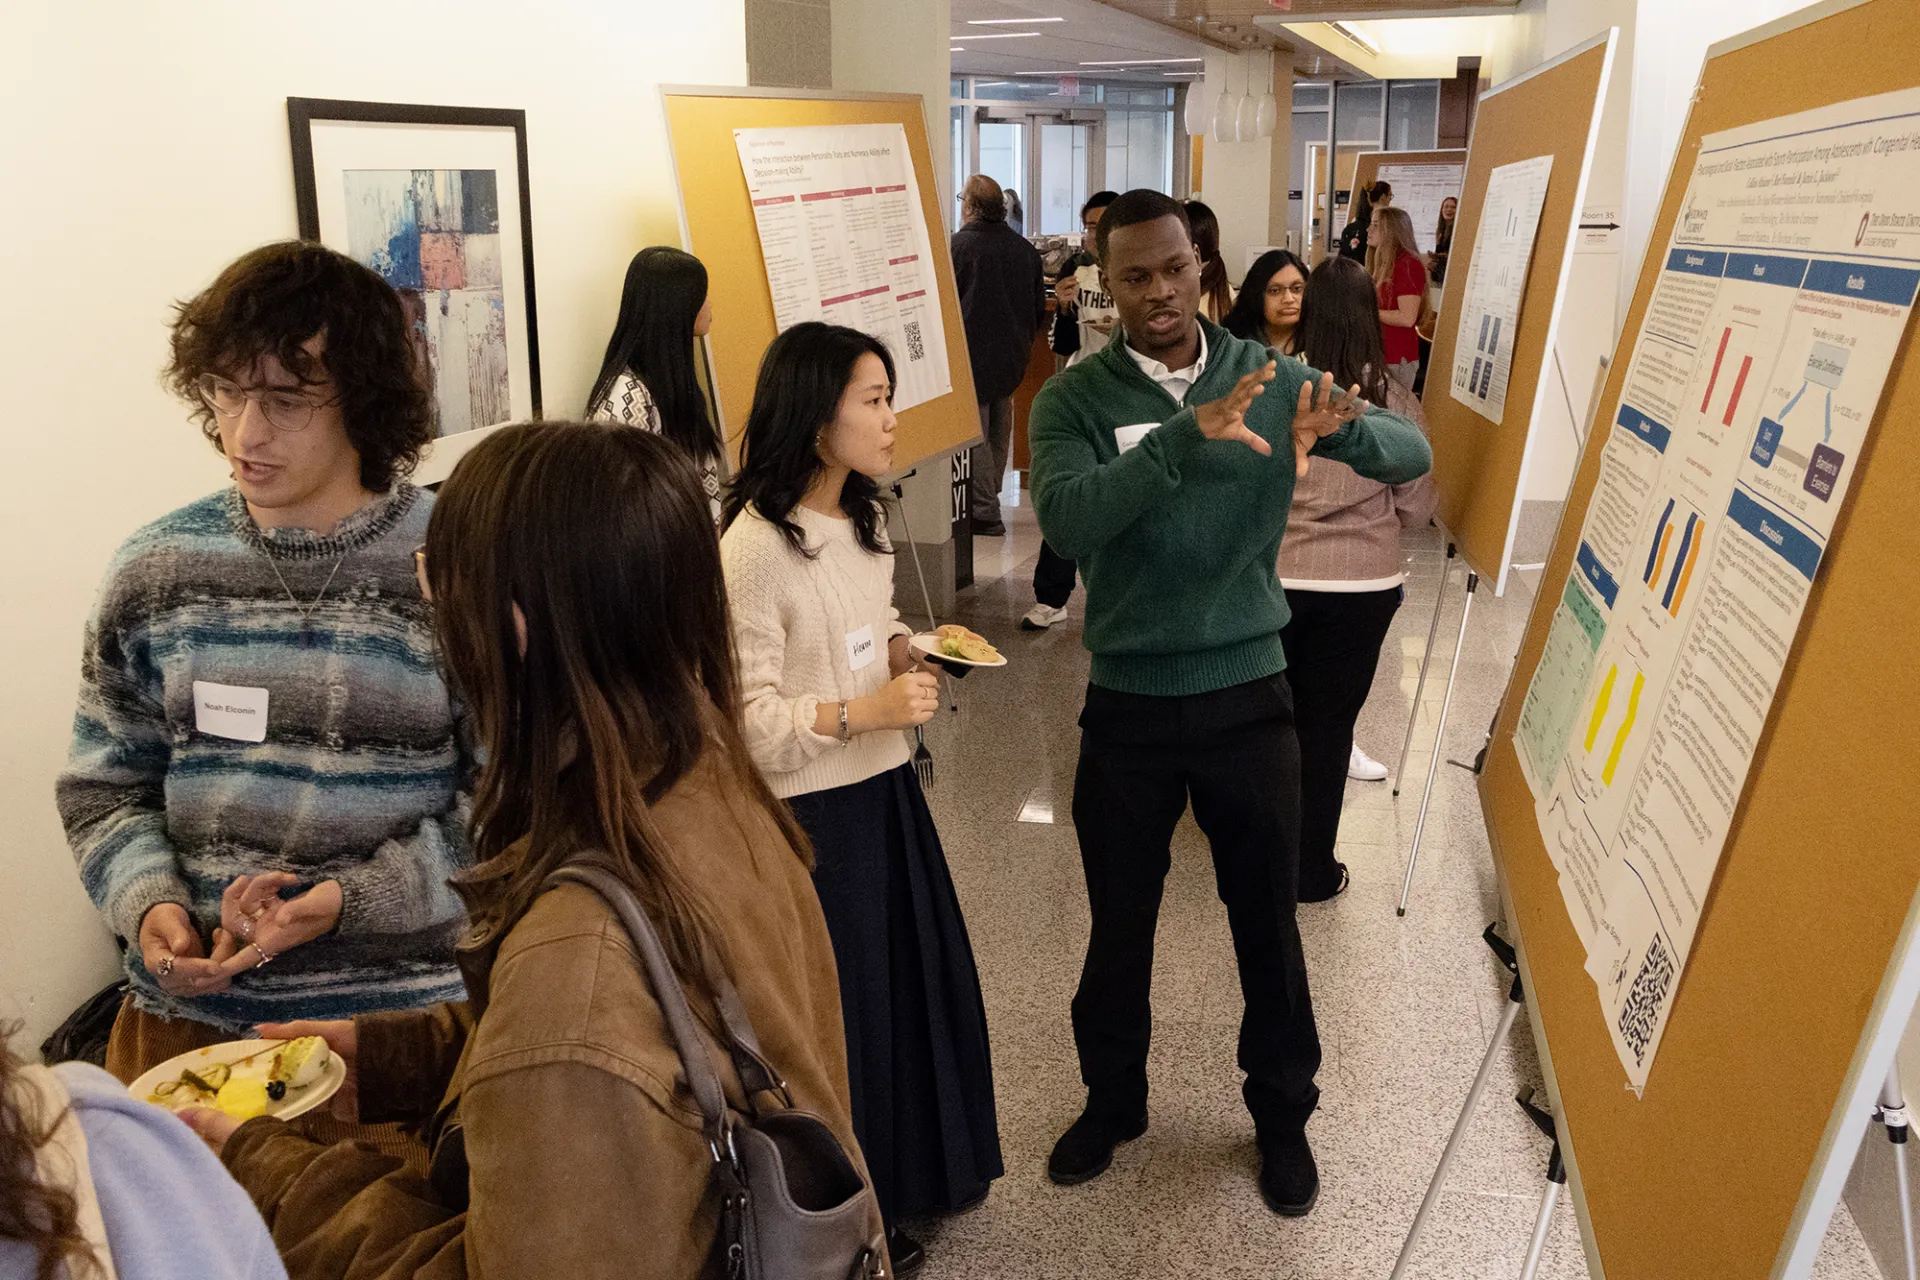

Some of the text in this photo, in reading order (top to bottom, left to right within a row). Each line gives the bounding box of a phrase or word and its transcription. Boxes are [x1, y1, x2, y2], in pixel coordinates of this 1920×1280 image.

[1873, 132, 1911, 158] Congenital
[1581, 211, 1615, 219] Room 35
[952, 484, 966, 522] Y!
[204, 702, 256, 715] Noah Elconin
